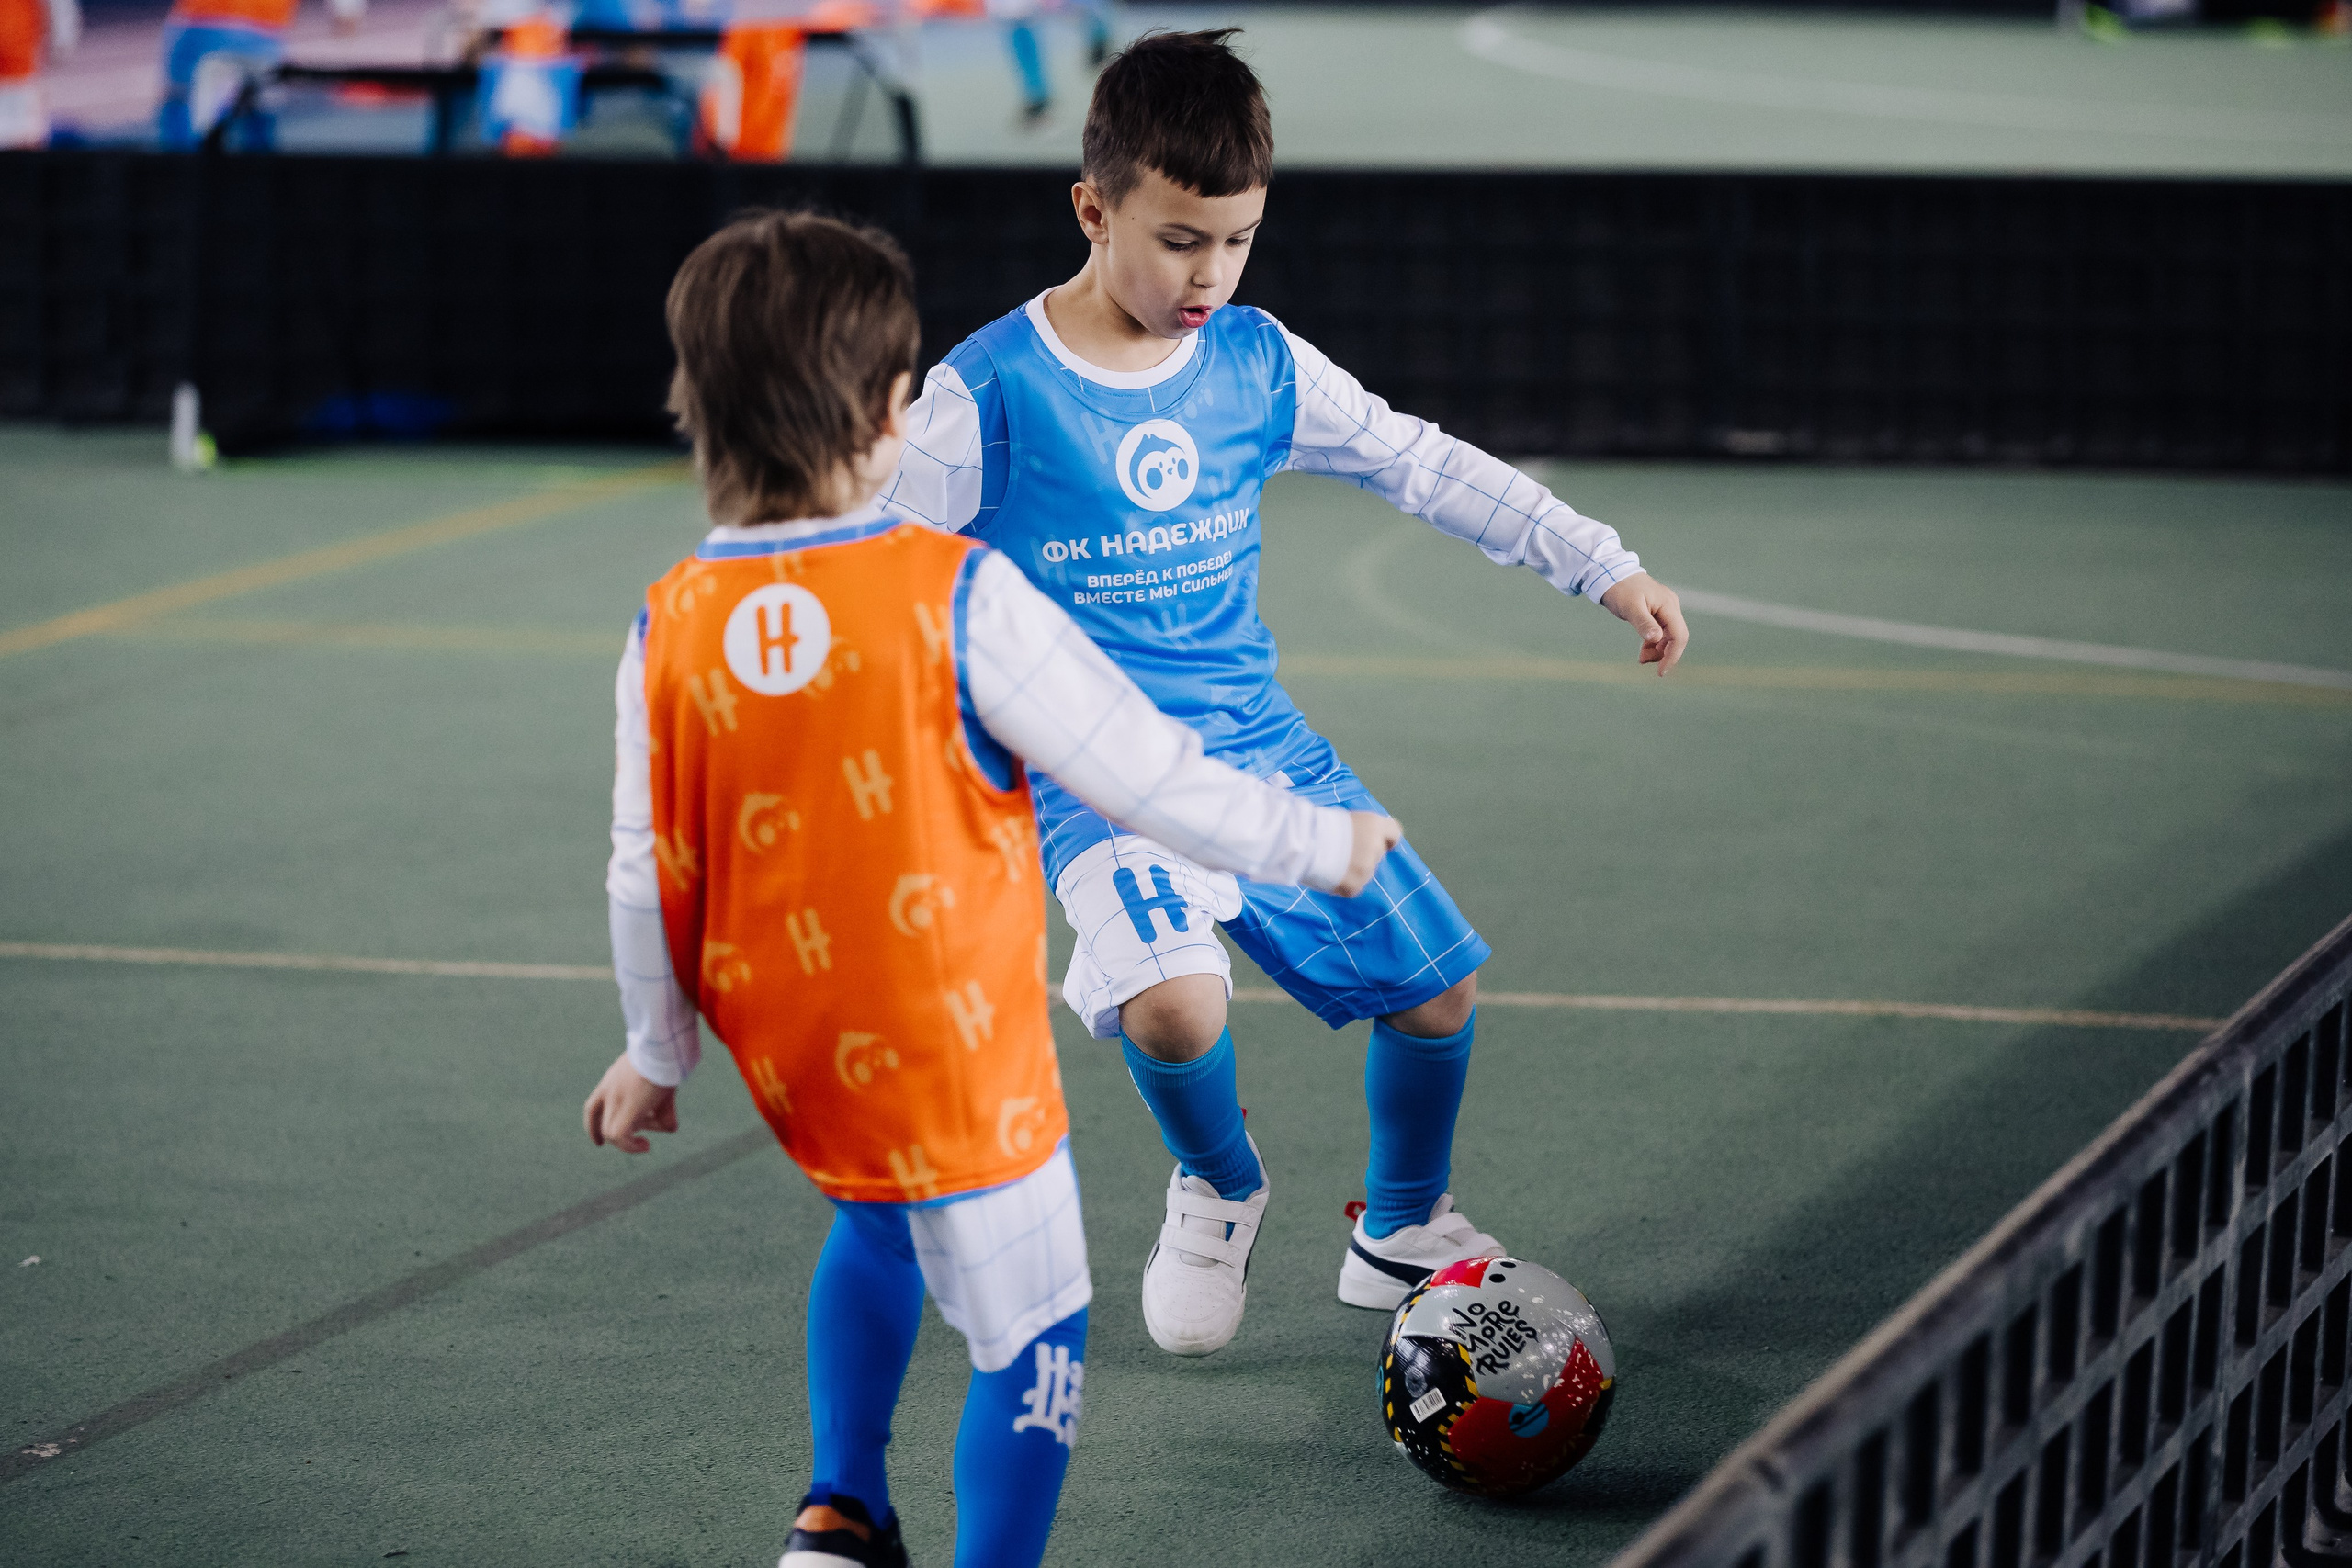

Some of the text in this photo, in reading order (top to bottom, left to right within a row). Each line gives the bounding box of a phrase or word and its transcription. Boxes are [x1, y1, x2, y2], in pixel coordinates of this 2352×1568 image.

[1042, 507, 1250, 562] ФК НАДЕЖДИК
[1087, 550, 1232, 588] ВПЕРЁД К ПОБЕДЕ!
[1074, 589, 1146, 604] ВМЕСТЕ
[1149, 583, 1178, 600] МЫ
[1476, 1319, 1540, 1376] RULES
